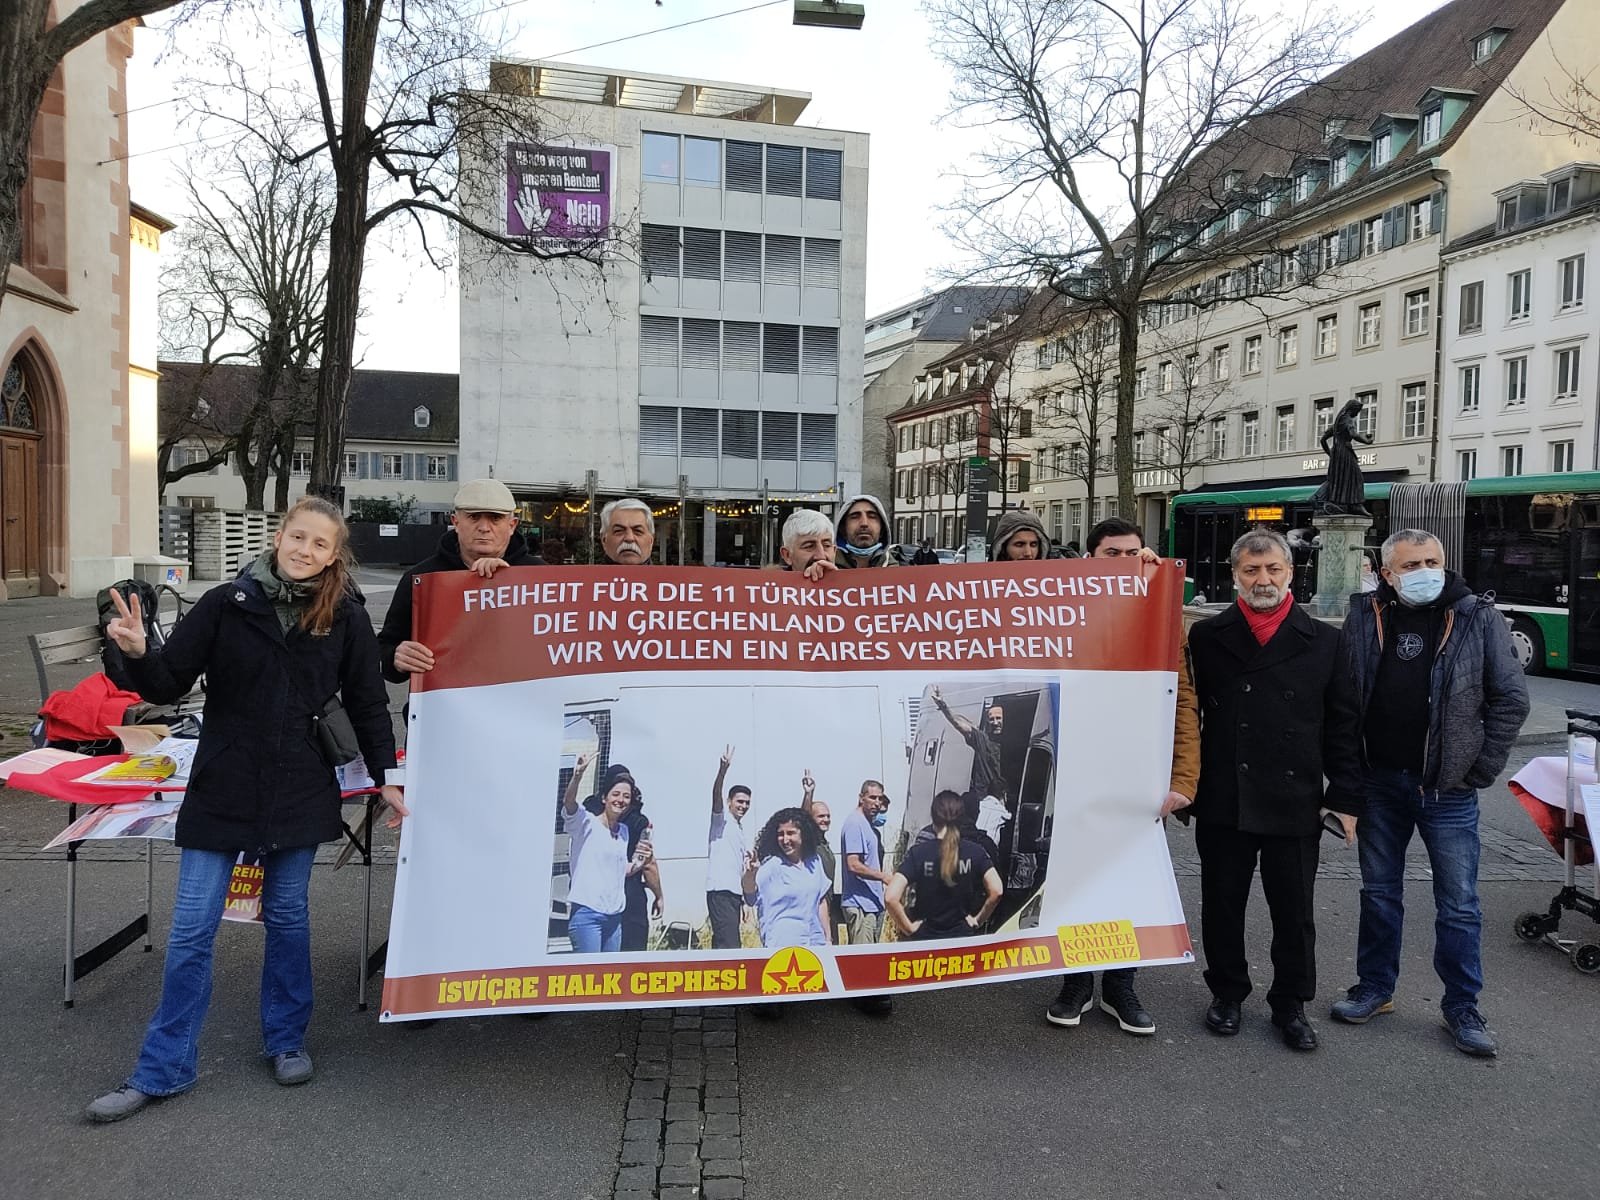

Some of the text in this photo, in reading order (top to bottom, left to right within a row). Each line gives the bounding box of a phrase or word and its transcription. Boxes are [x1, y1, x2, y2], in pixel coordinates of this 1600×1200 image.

[547, 154, 568, 170] weg
[569, 155, 587, 168] von
[564, 172, 600, 188] Renten!
[566, 198, 601, 226] Nein
[1302, 459, 1319, 470] BAR
[463, 575, 1148, 612] FREIHEIT FÜR DIE 11 TÜRKISCHEN ANTIFASCHISTEN
[533, 605, 1086, 638] DIE IN GRIECHENLAND GEFANGEN SIND!
[547, 636, 1073, 666] WIR WOLLEN EIN FAIRES VERFAHREN!
[229, 879, 252, 895] ÜR
[1071, 921, 1120, 937] TAYAD
[1062, 933, 1135, 952] KOMITEE
[888, 944, 1052, 982] İSVİÇRE TAYAD
[1066, 946, 1138, 964] SCHWEIZ
[437, 963, 747, 1005] İSVİÇRE HALK CEPHESİ
